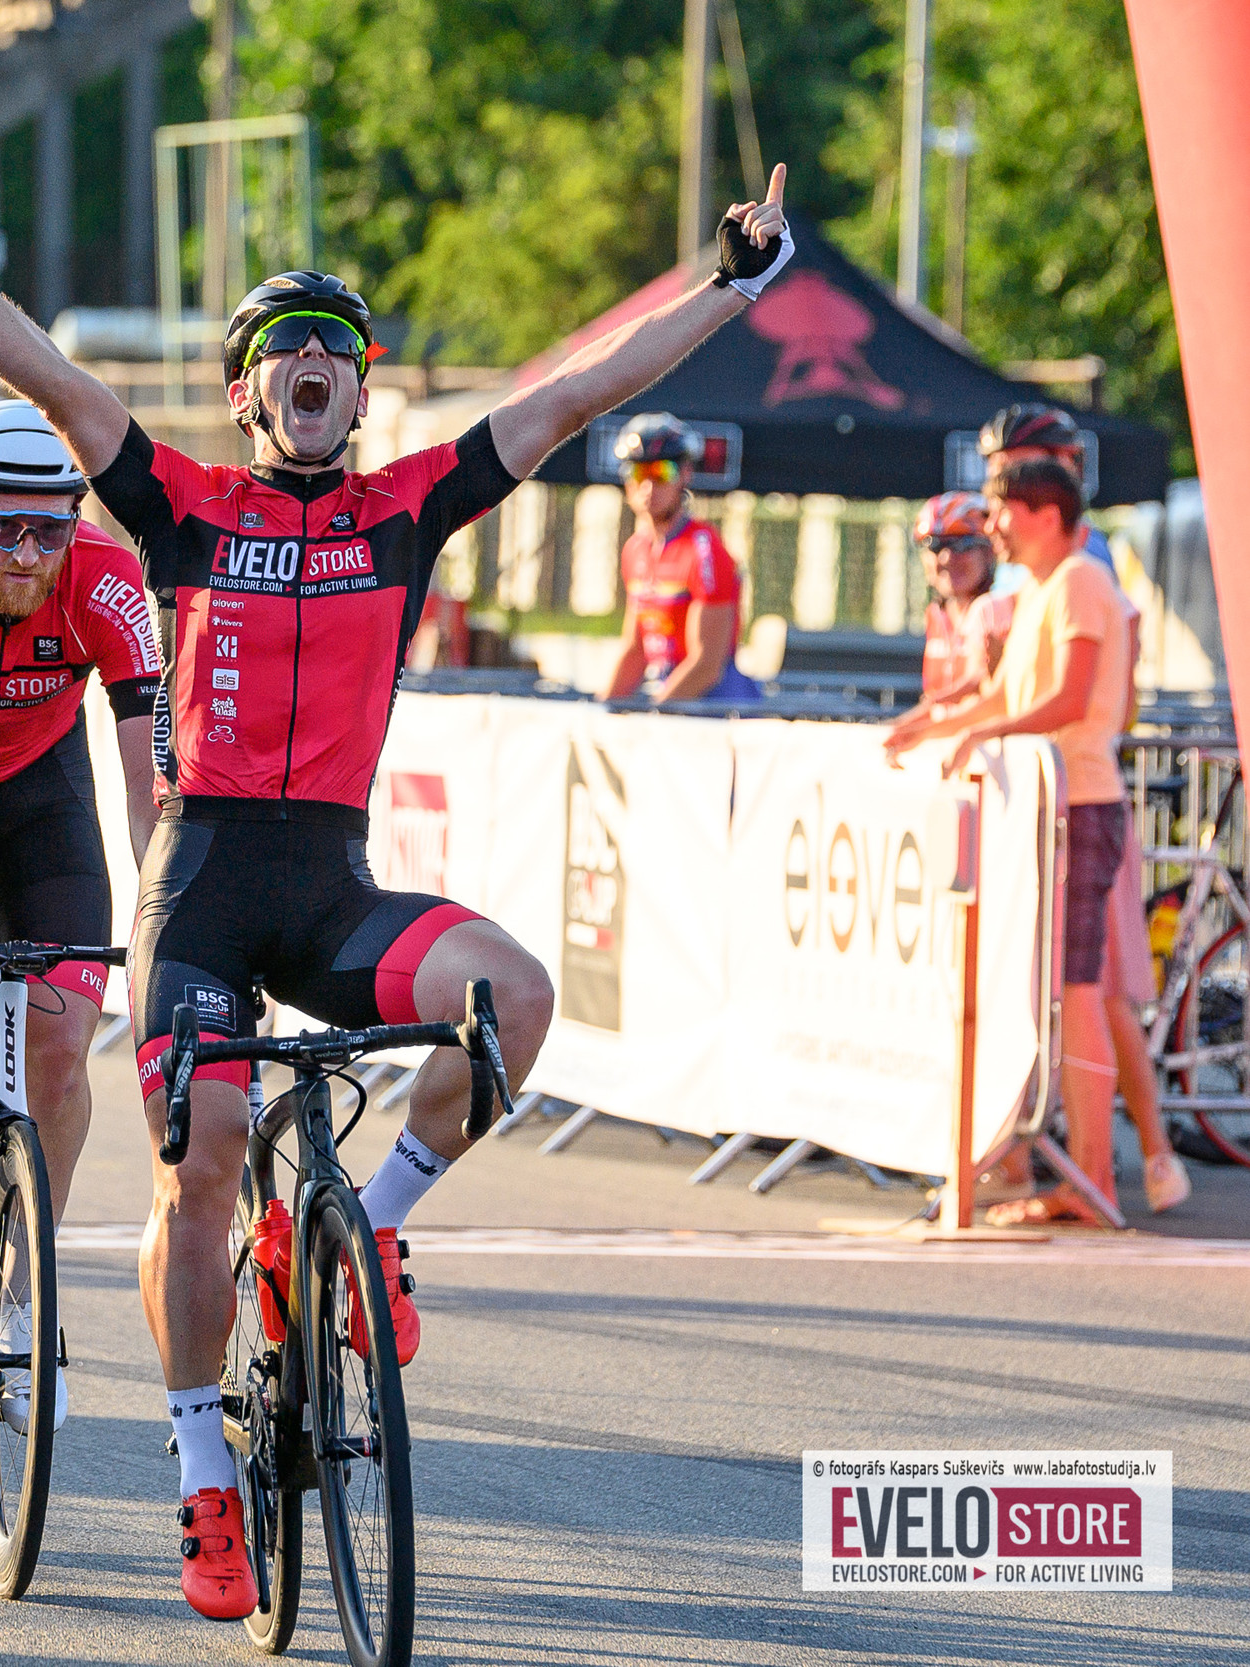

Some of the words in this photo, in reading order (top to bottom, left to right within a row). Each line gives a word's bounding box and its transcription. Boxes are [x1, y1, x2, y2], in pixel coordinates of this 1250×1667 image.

[211, 535, 299, 581] EVELO
[308, 545, 368, 577] STORE
[91, 573, 148, 625] EVELO
[209, 575, 283, 593] EVELOSTORE.COM
[300, 584, 318, 595] FOR
[319, 580, 350, 593] ACTIVE
[350, 576, 377, 589] LIVING
[38, 639, 57, 648] BSC
[196, 990, 228, 1006] BSC
[4, 1001, 15, 1093] LOOK
